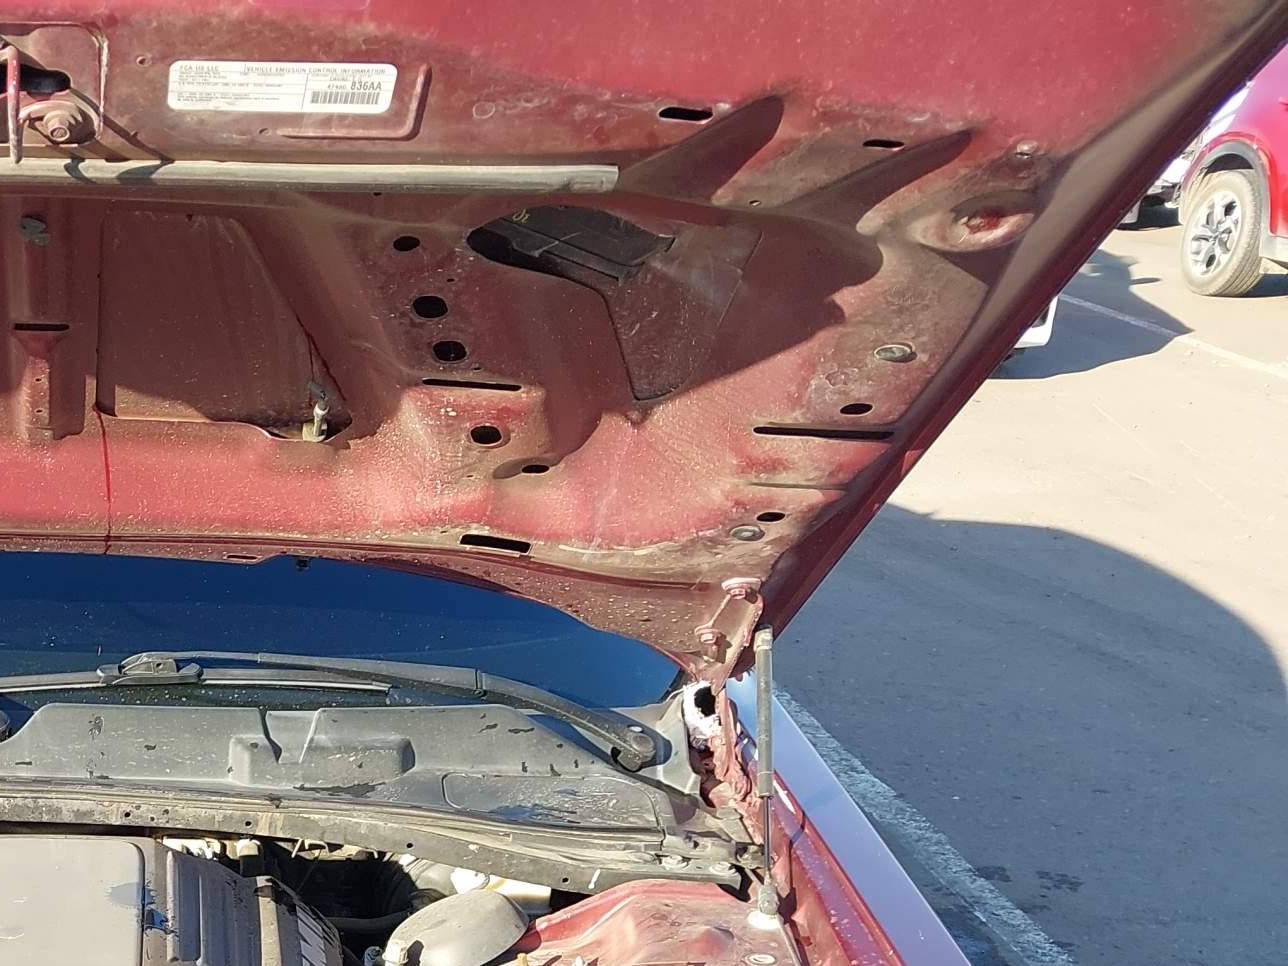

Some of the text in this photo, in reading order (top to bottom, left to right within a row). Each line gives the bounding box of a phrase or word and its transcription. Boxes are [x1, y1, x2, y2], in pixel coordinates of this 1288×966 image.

[246, 65, 272, 73] VEHICLE
[341, 67, 386, 75] INFORMATION
[350, 81, 382, 91] 836AA
